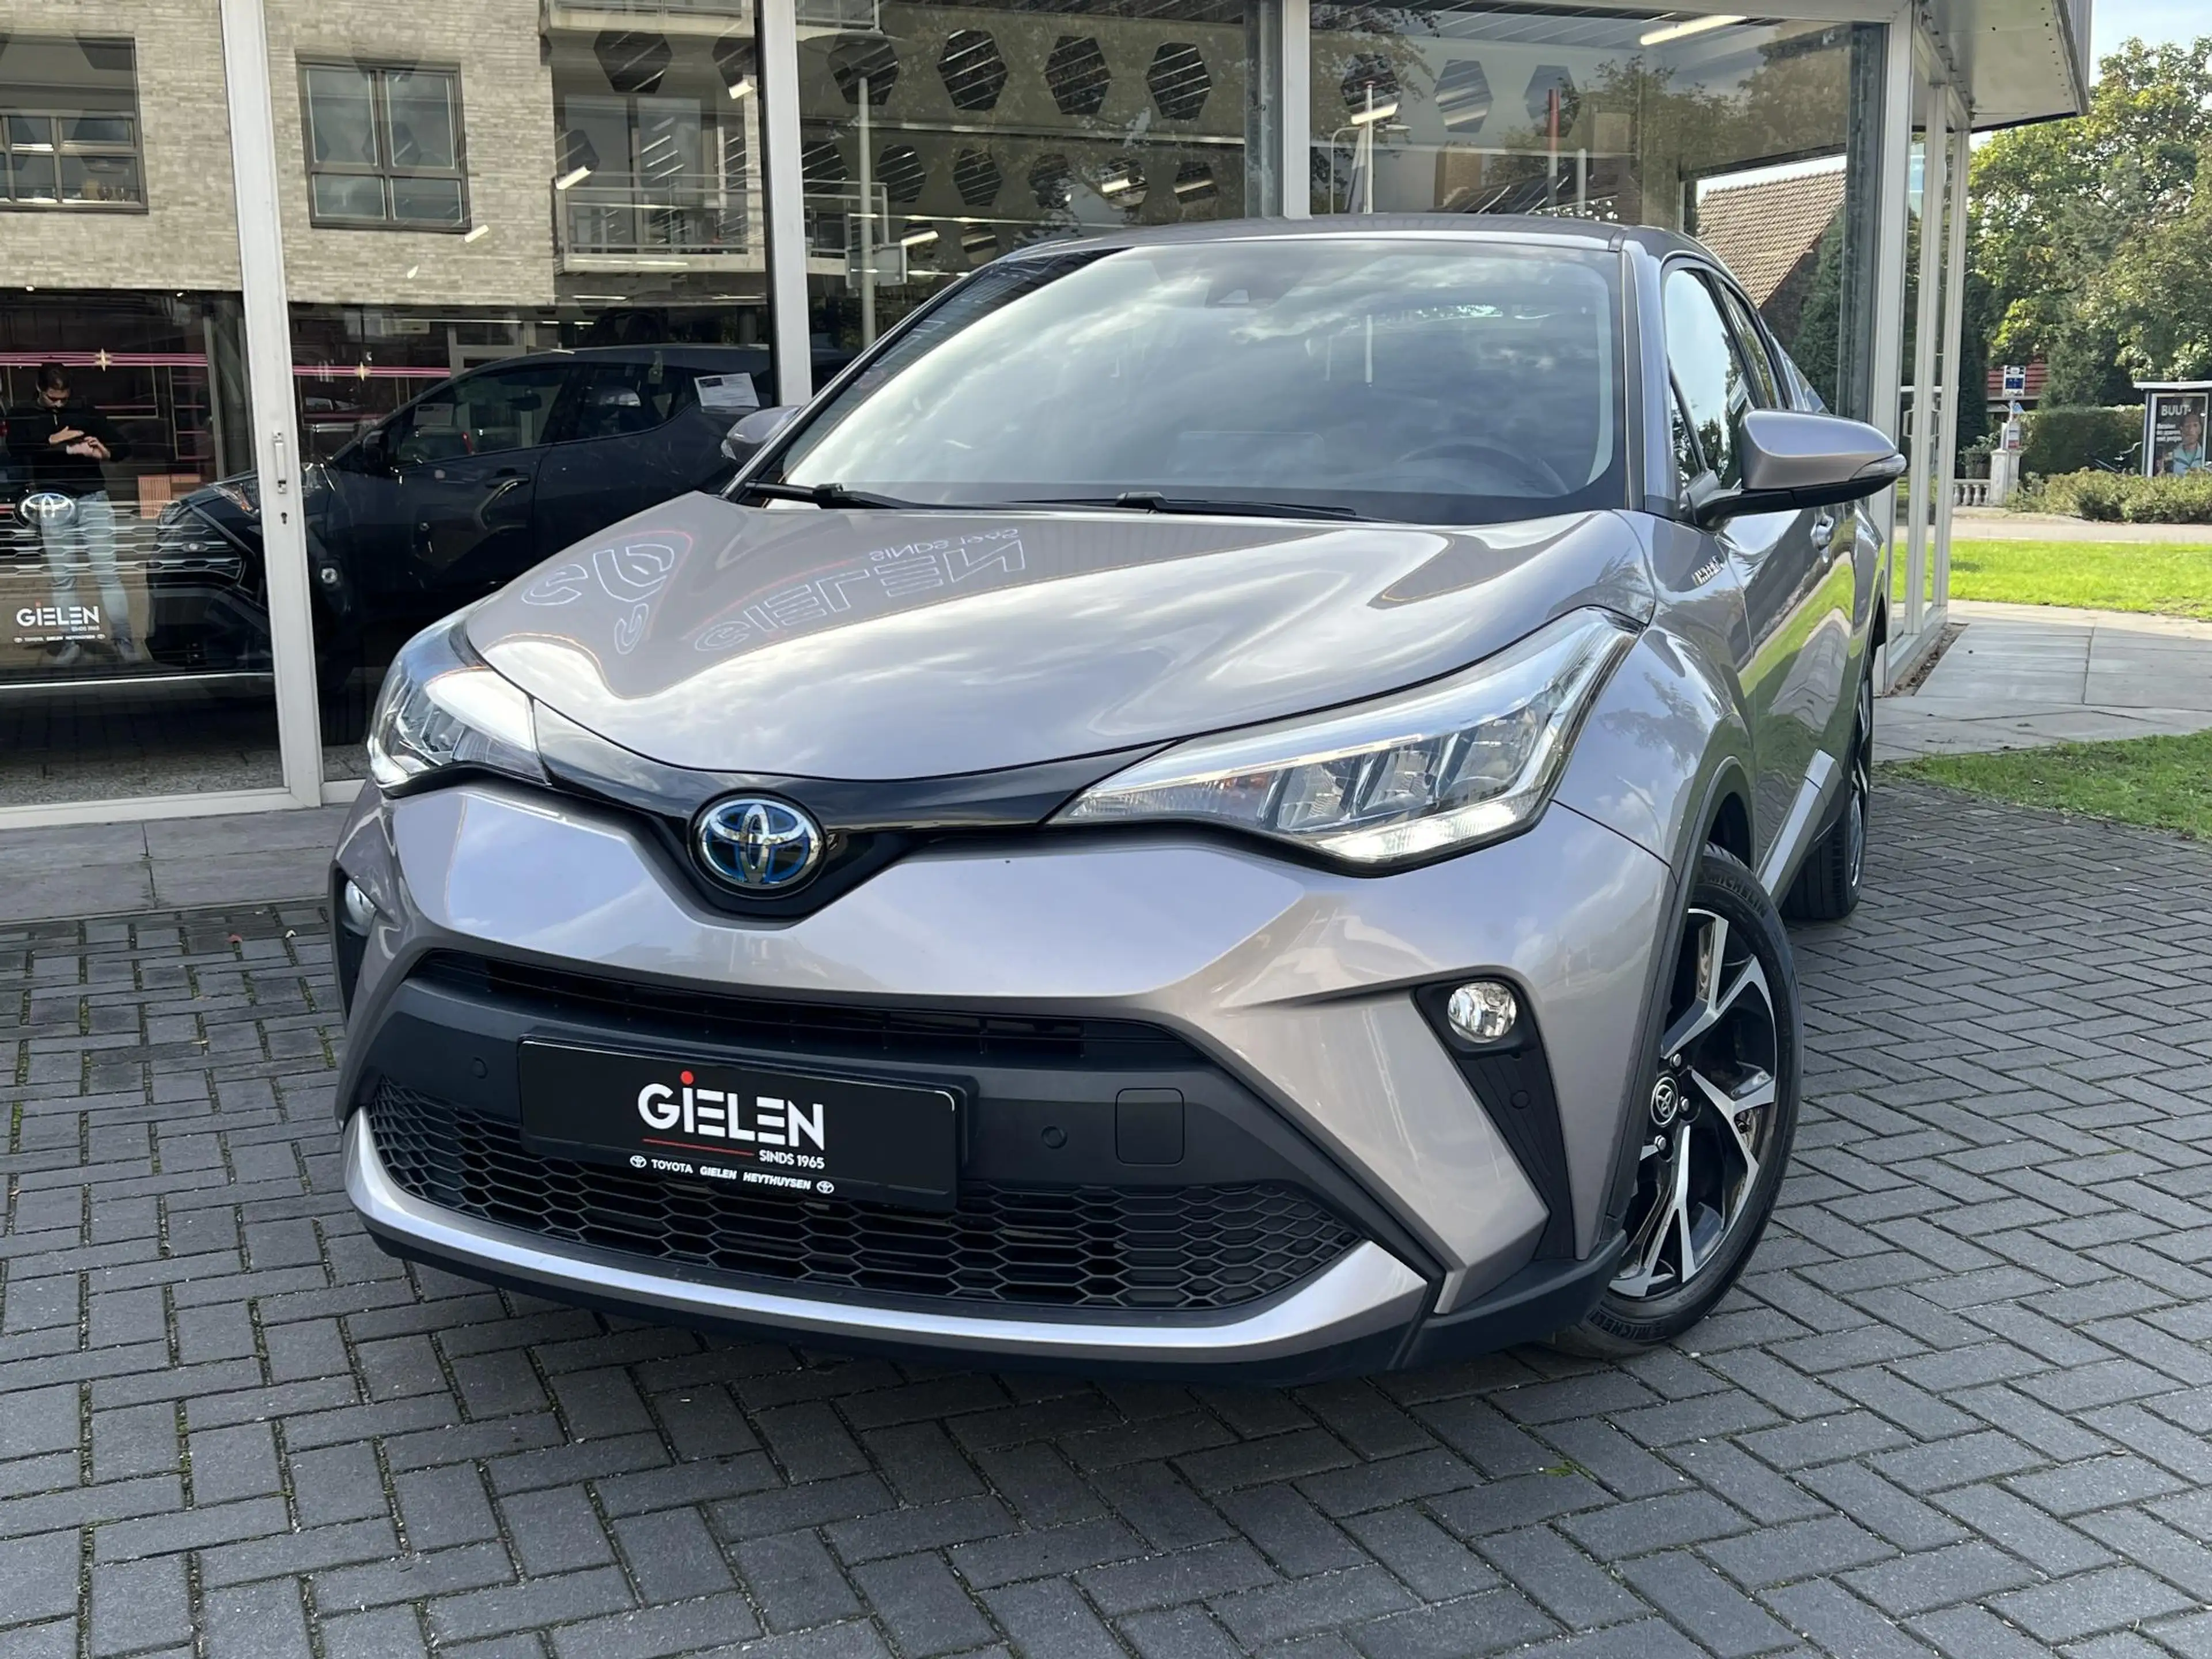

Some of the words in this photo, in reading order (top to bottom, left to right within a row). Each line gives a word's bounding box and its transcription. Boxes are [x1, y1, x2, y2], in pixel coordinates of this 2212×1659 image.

[16, 601, 100, 627] GIELEN
[638, 1070, 825, 1151] GIELEN
[651, 1158, 694, 1174] TOYOTA
[699, 1165, 737, 1180] GIELEN
[743, 1172, 812, 1190] HEYTHUYSEN
[759, 1149, 794, 1166] SINDS
[797, 1155, 825, 1170] 1965
